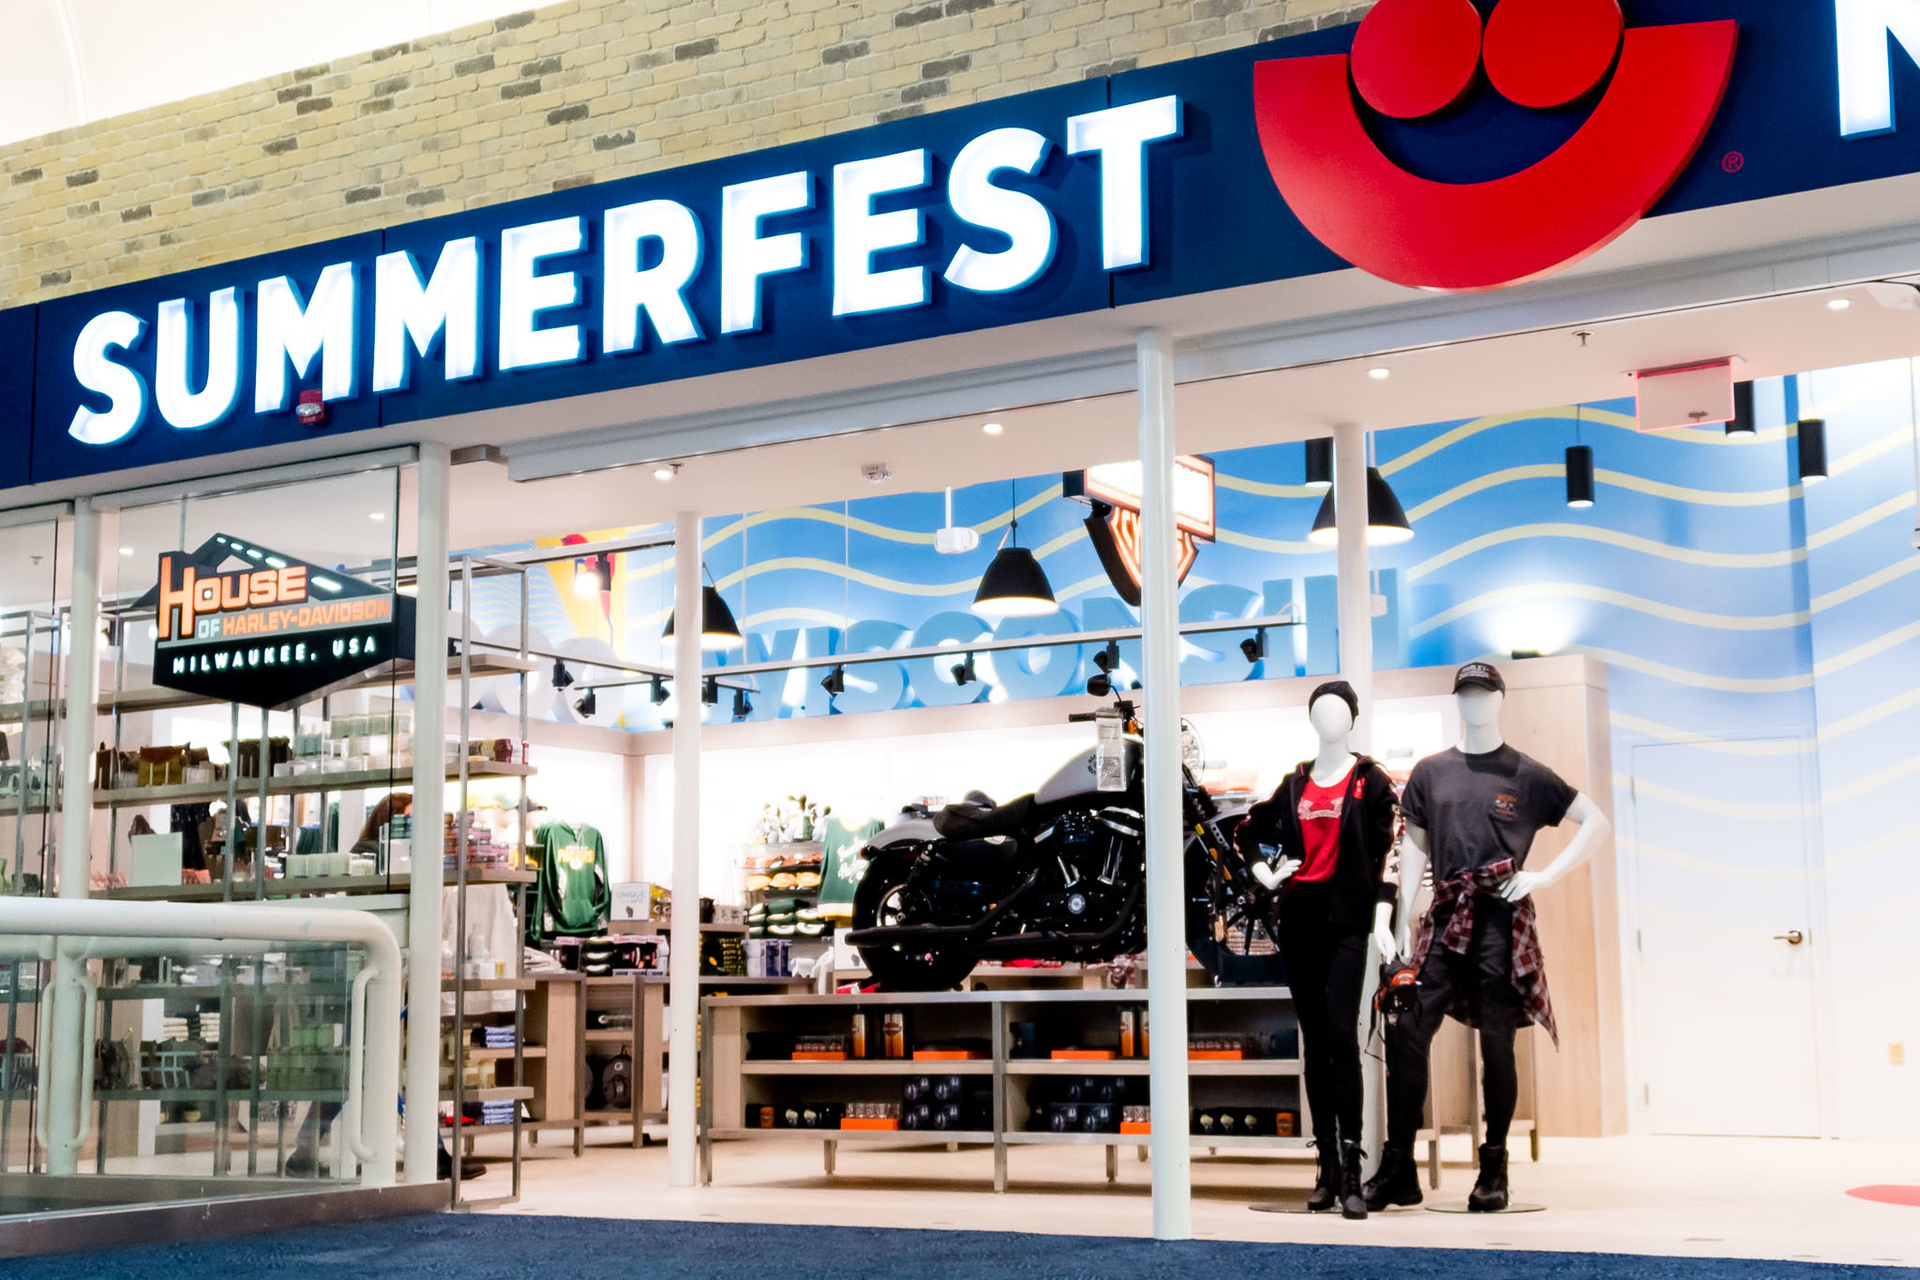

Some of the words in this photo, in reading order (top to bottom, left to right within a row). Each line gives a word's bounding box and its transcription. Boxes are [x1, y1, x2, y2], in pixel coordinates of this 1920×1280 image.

[68, 94, 1180, 446] SUMMERFEST
[198, 617, 221, 639] OF
[222, 598, 390, 636] HARLEY-DAVIDSON
[173, 643, 317, 675] MILWAUKEE,
[332, 636, 376, 657] USA
